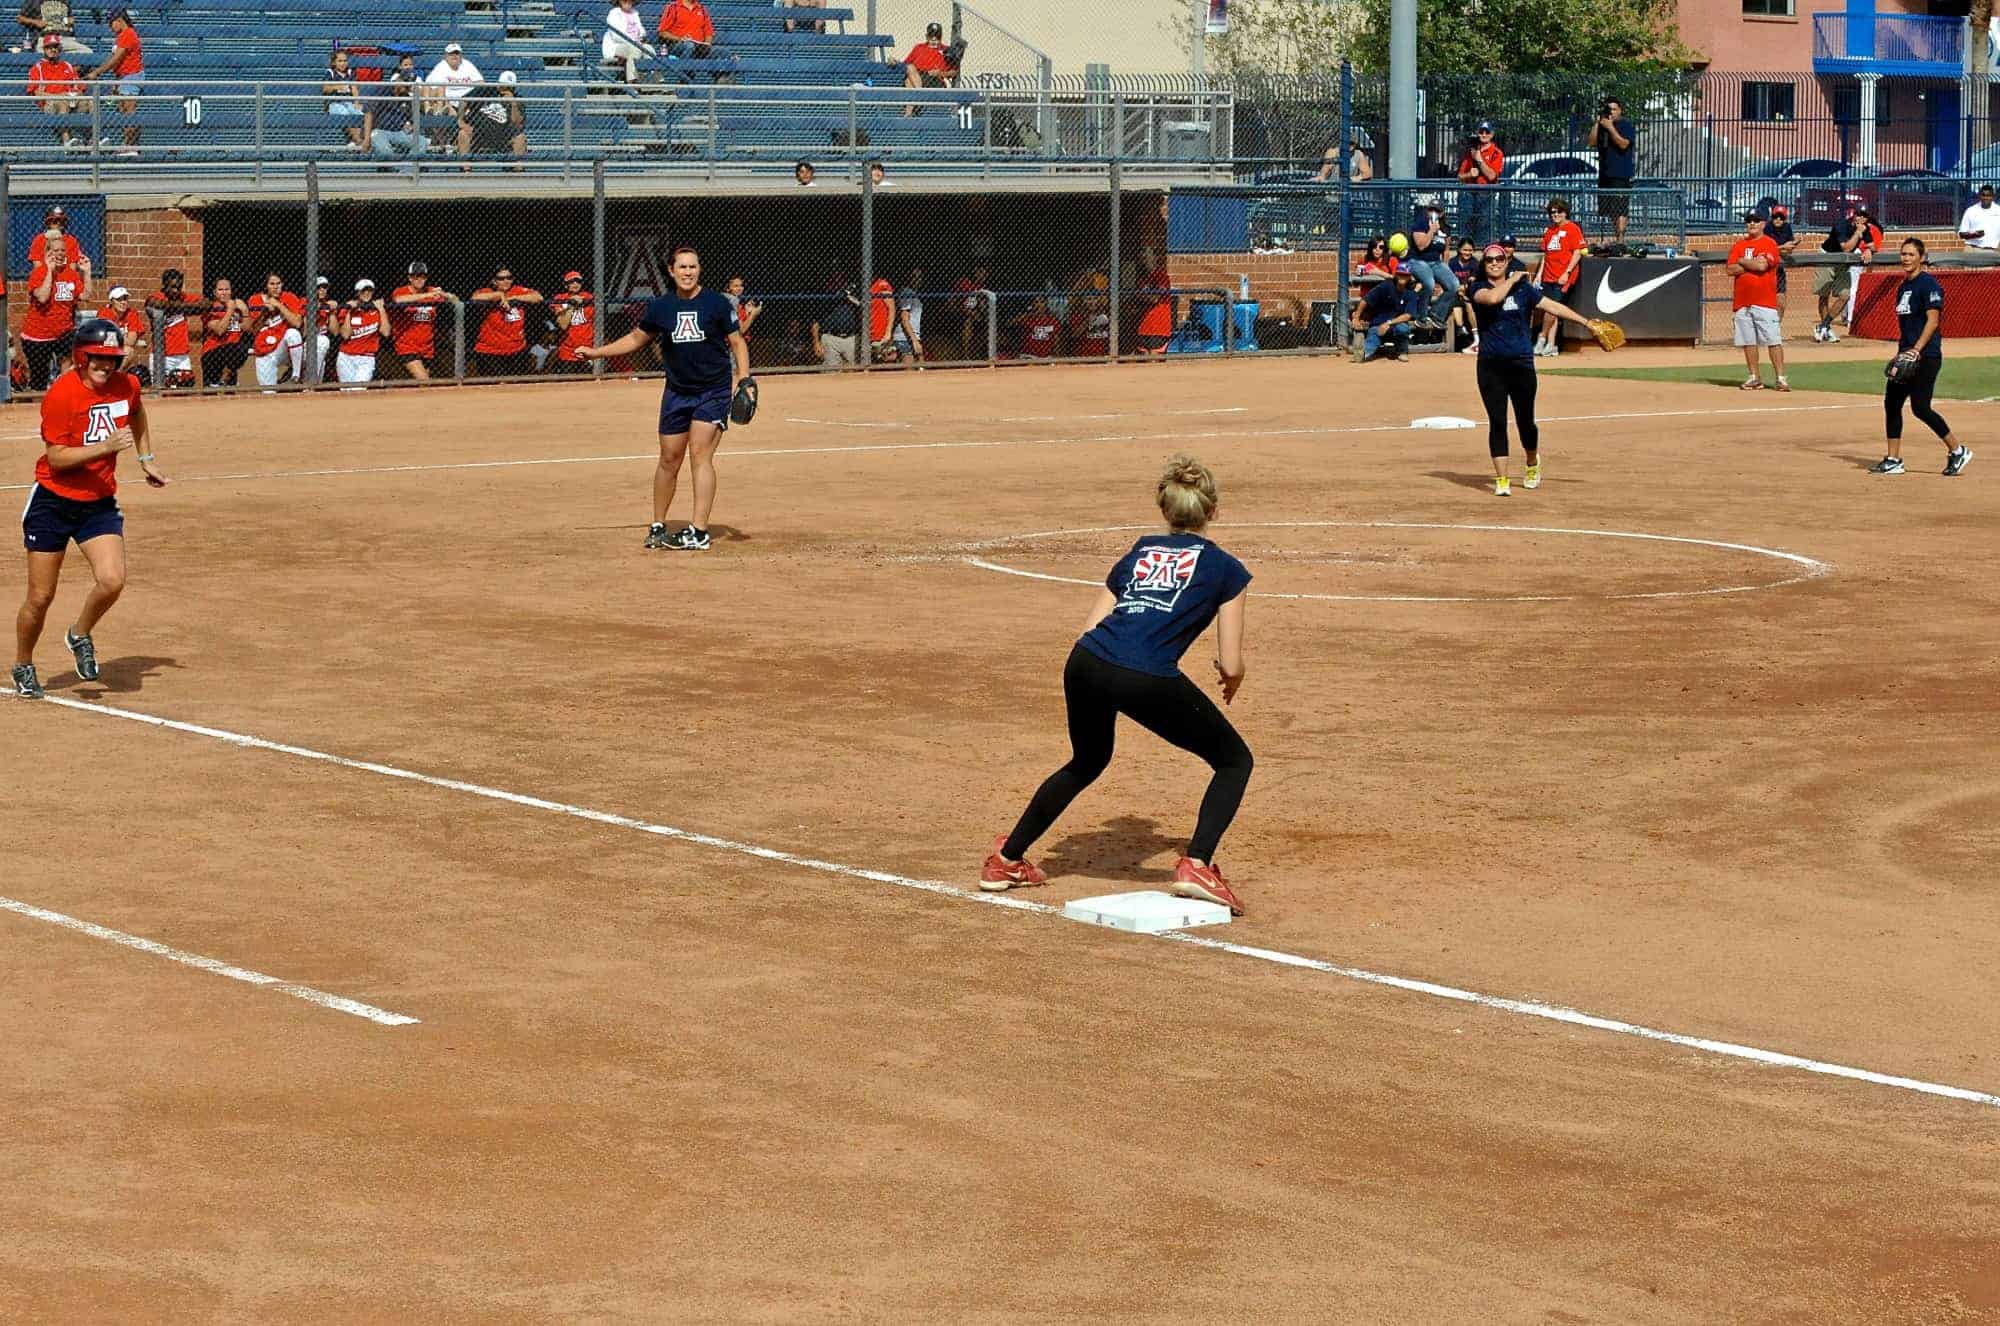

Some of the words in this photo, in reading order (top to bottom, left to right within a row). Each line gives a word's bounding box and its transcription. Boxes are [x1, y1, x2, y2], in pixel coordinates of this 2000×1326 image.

[184, 99, 201, 123] 10
[958, 106, 972, 129] 11
[104, 331, 119, 347] A
[671, 312, 705, 342] A
[1134, 562, 1180, 590] A
